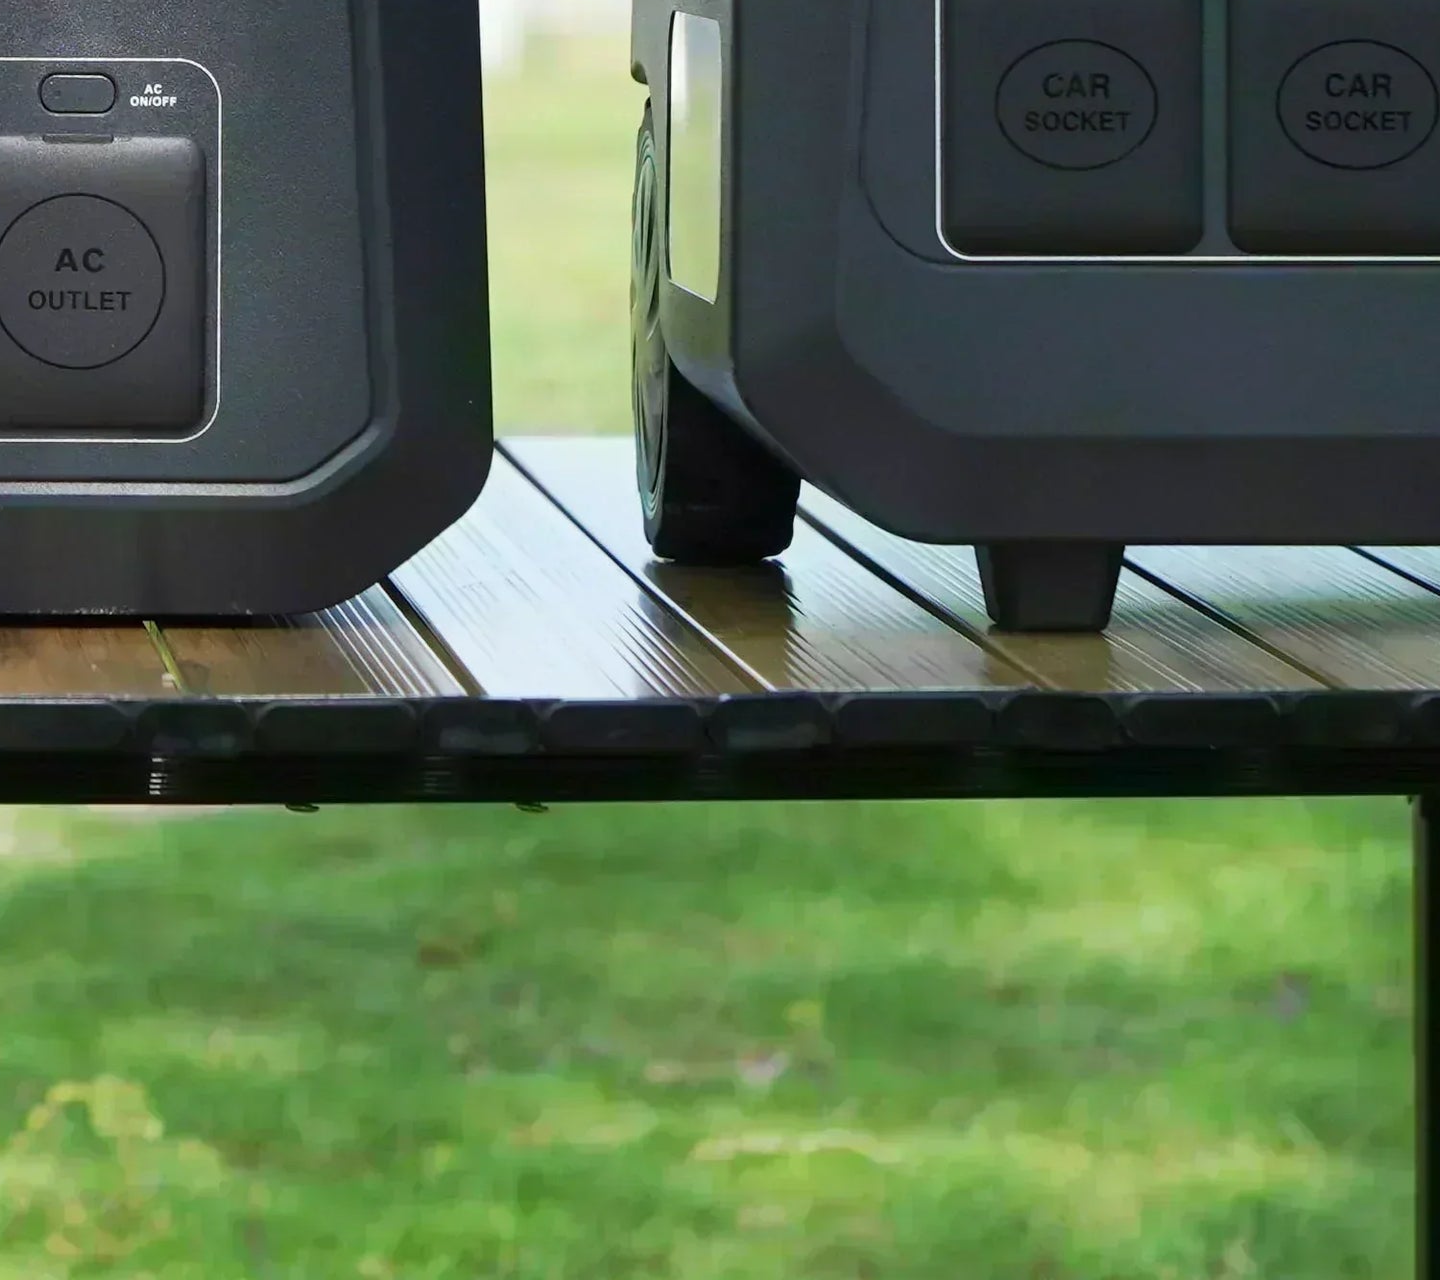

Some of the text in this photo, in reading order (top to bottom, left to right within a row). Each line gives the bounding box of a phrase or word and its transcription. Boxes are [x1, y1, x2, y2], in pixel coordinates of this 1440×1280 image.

[143, 83, 163, 95] AC
[1041, 72, 1111, 99] CAR
[1323, 72, 1393, 99] CAR
[129, 95, 178, 107] ON/OFF
[1023, 110, 1132, 132] SOCKET
[1304, 110, 1413, 132] SOCKET
[53, 247, 106, 273] AC
[27, 289, 132, 311] OUTLET
